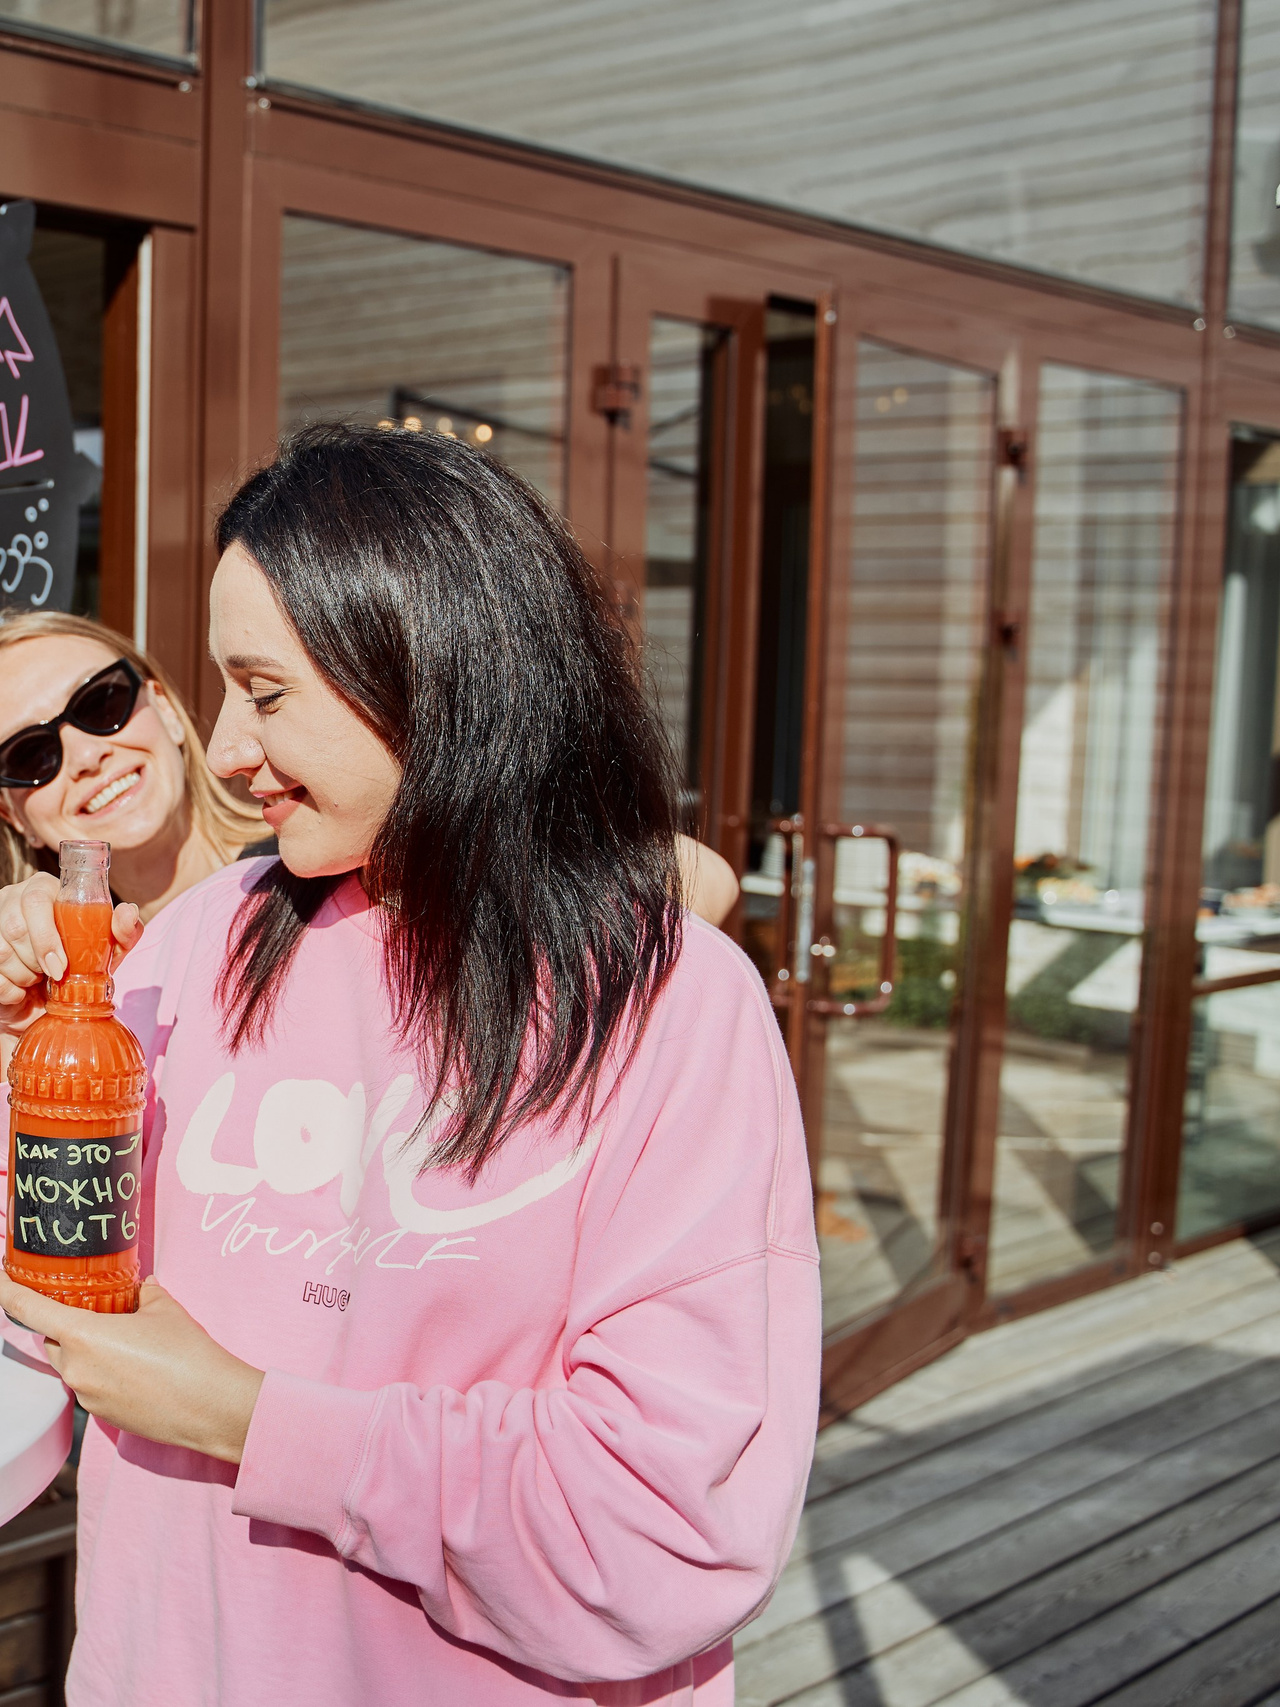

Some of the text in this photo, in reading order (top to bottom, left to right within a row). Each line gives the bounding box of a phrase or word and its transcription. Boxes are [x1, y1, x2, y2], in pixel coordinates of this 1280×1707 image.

[17, 1137, 111, 1165] КАК ЭТО
[16, 1172, 136, 1211] МОЖНО
[302, 1281, 351, 1312] HUG
